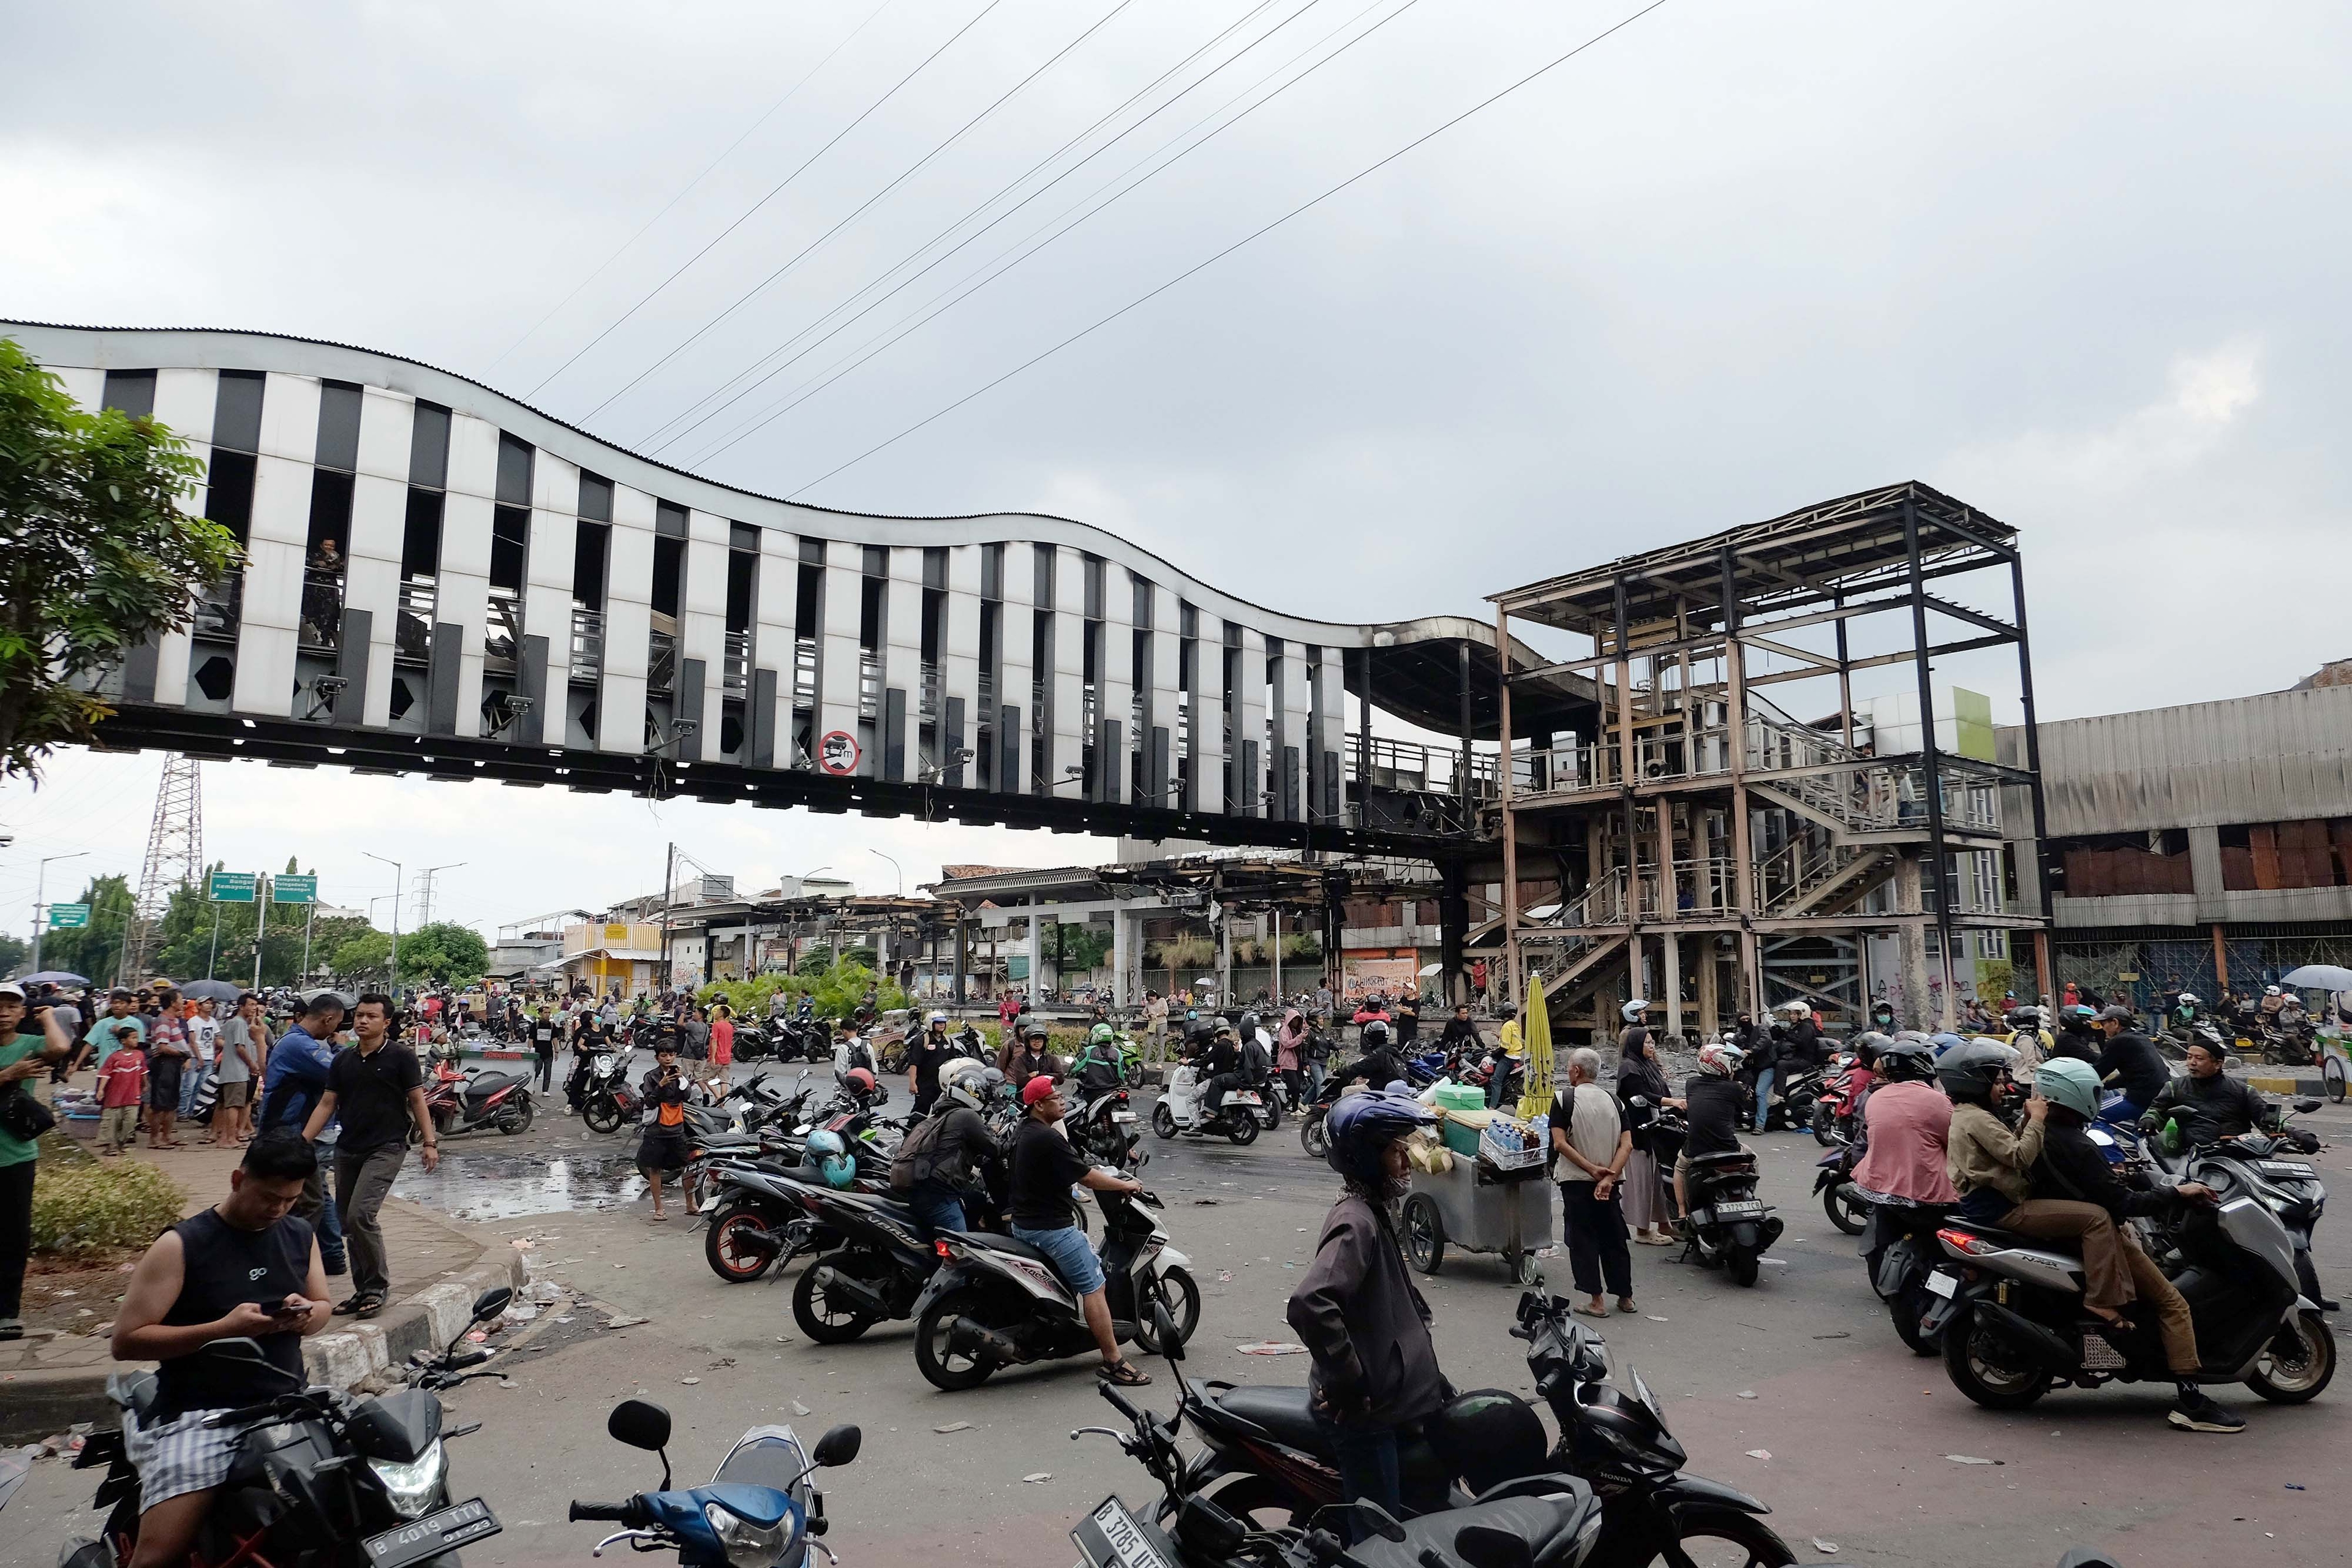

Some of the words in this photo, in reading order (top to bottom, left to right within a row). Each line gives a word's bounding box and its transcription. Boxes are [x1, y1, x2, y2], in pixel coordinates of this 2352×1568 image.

[867, 1215, 918, 1244] VARIO
[249, 1267, 268, 1281] go
[1600, 1472, 1632, 1484] HONDA
[373, 1540, 388, 1556] B
[398, 1520, 442, 1545] 4019
[448, 1503, 482, 1523] TTV
[1096, 1504, 1114, 1521] B
[1106, 1515, 1140, 1555] 3785
